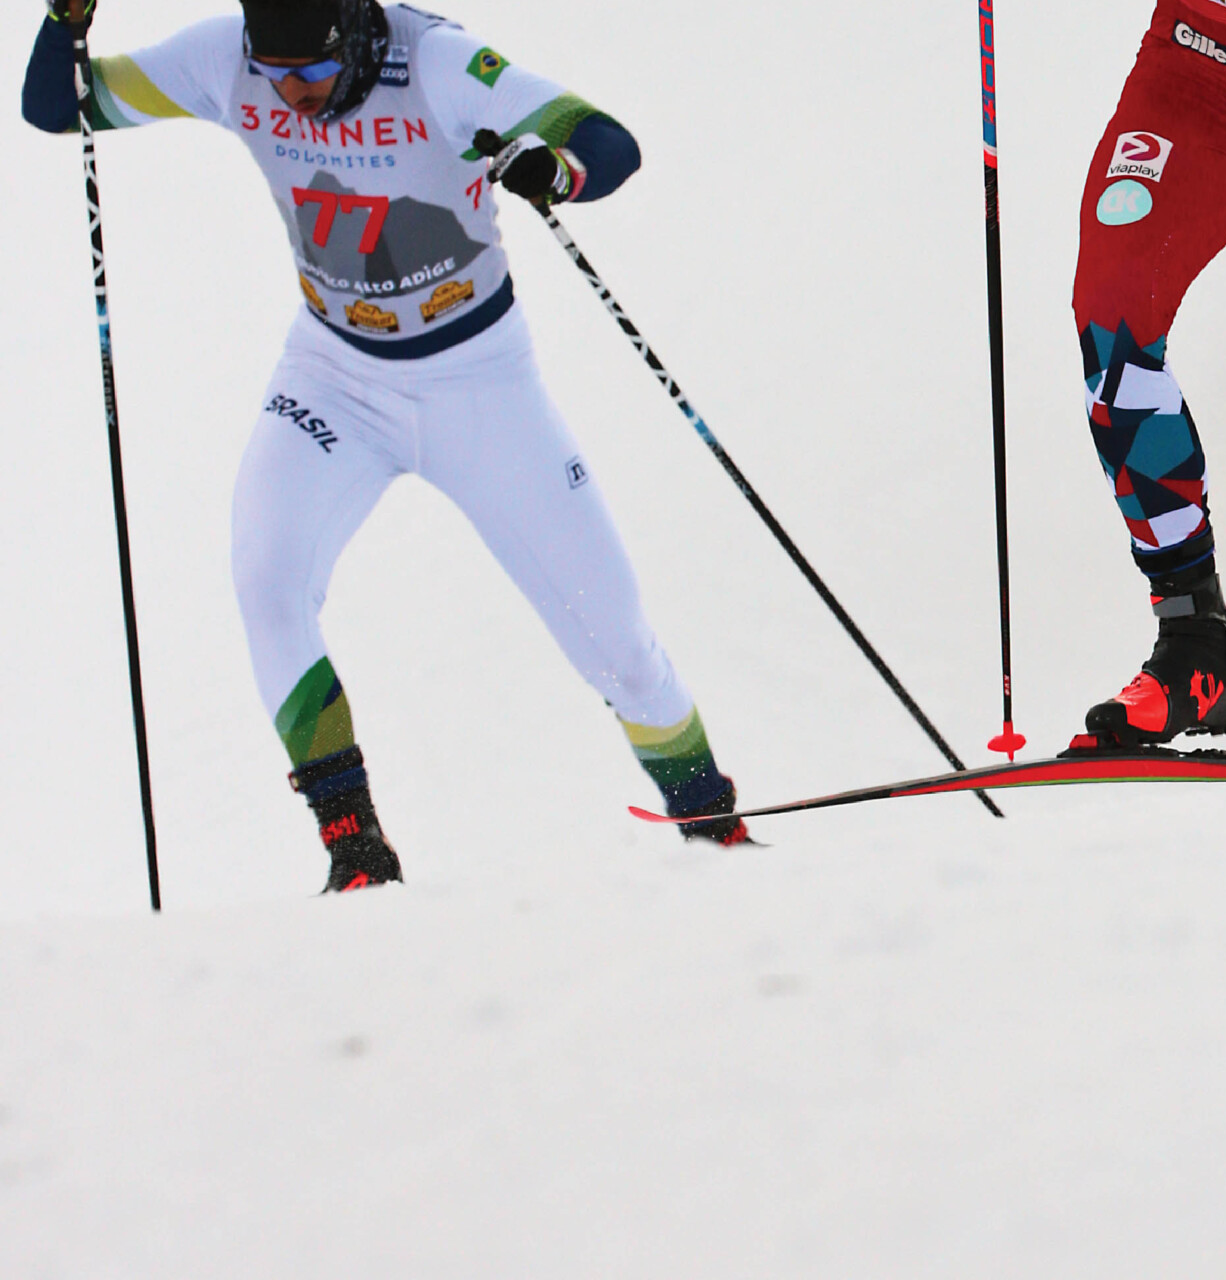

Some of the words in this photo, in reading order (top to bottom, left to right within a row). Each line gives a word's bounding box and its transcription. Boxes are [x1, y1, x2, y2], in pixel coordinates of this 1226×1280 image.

[240, 104, 260, 131] 3
[276, 144, 395, 168] DOLOMITES
[1110, 164, 1160, 178] viaplay
[292, 187, 388, 254] 77
